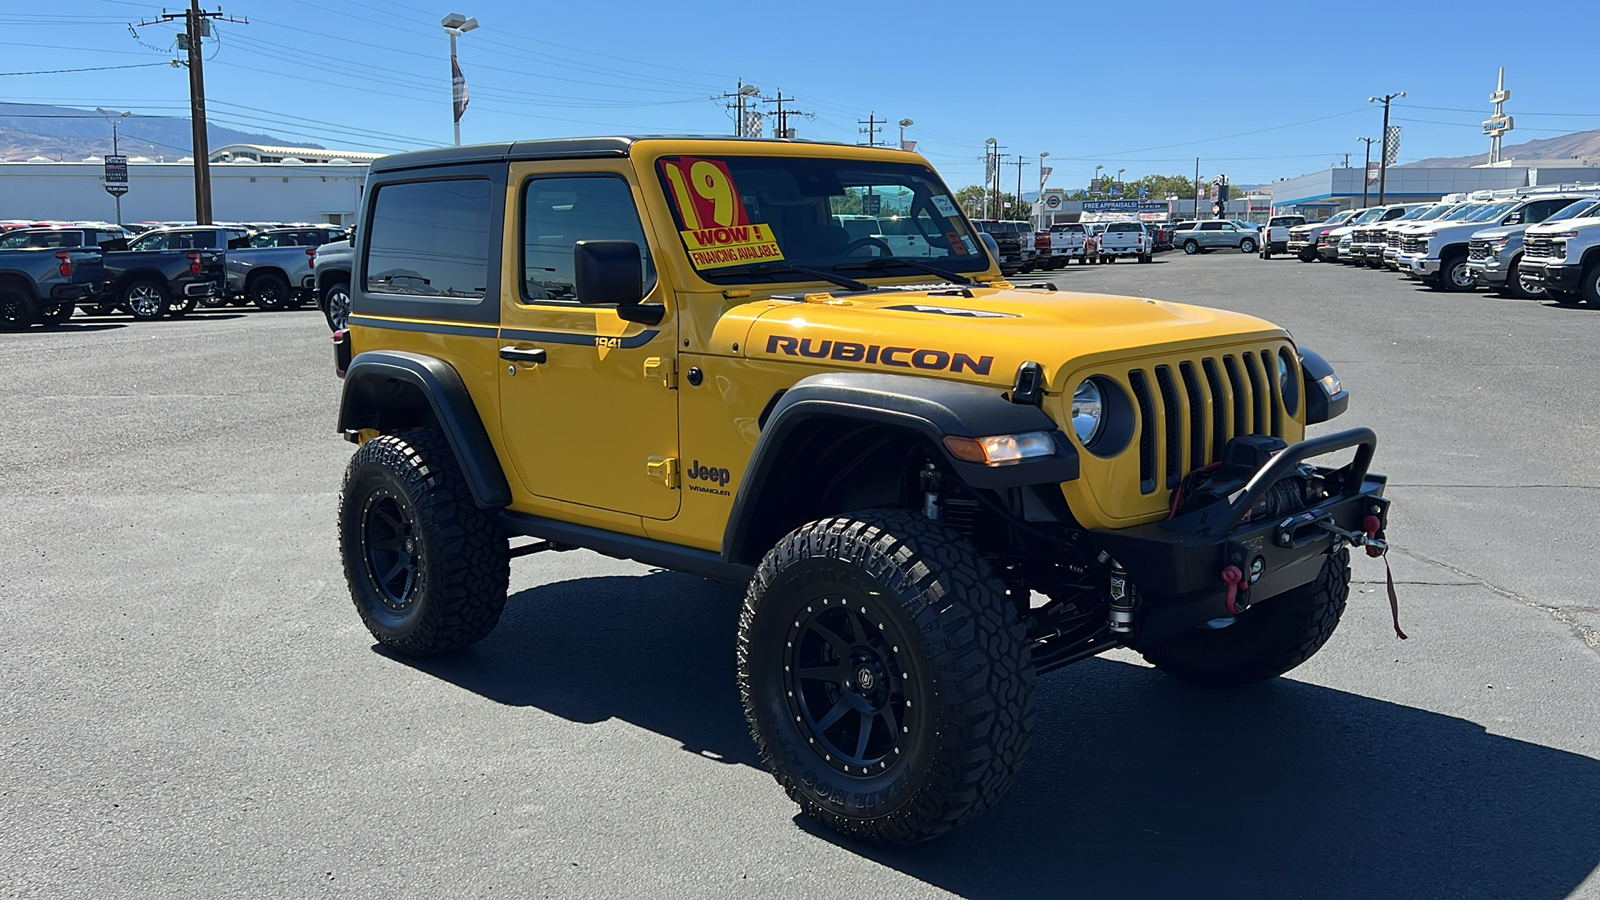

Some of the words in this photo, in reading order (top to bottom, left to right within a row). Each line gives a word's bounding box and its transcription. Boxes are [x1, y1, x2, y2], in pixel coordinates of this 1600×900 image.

[665, 160, 738, 230] 19
[692, 227, 750, 247] WOW
[692, 248, 738, 266] FINANCING
[736, 244, 779, 260] AVAILABLE
[594, 337, 622, 349] 1941
[765, 334, 994, 376] RUBICON
[687, 459, 730, 487] Jeep
[688, 484, 731, 497] WRANGLER
